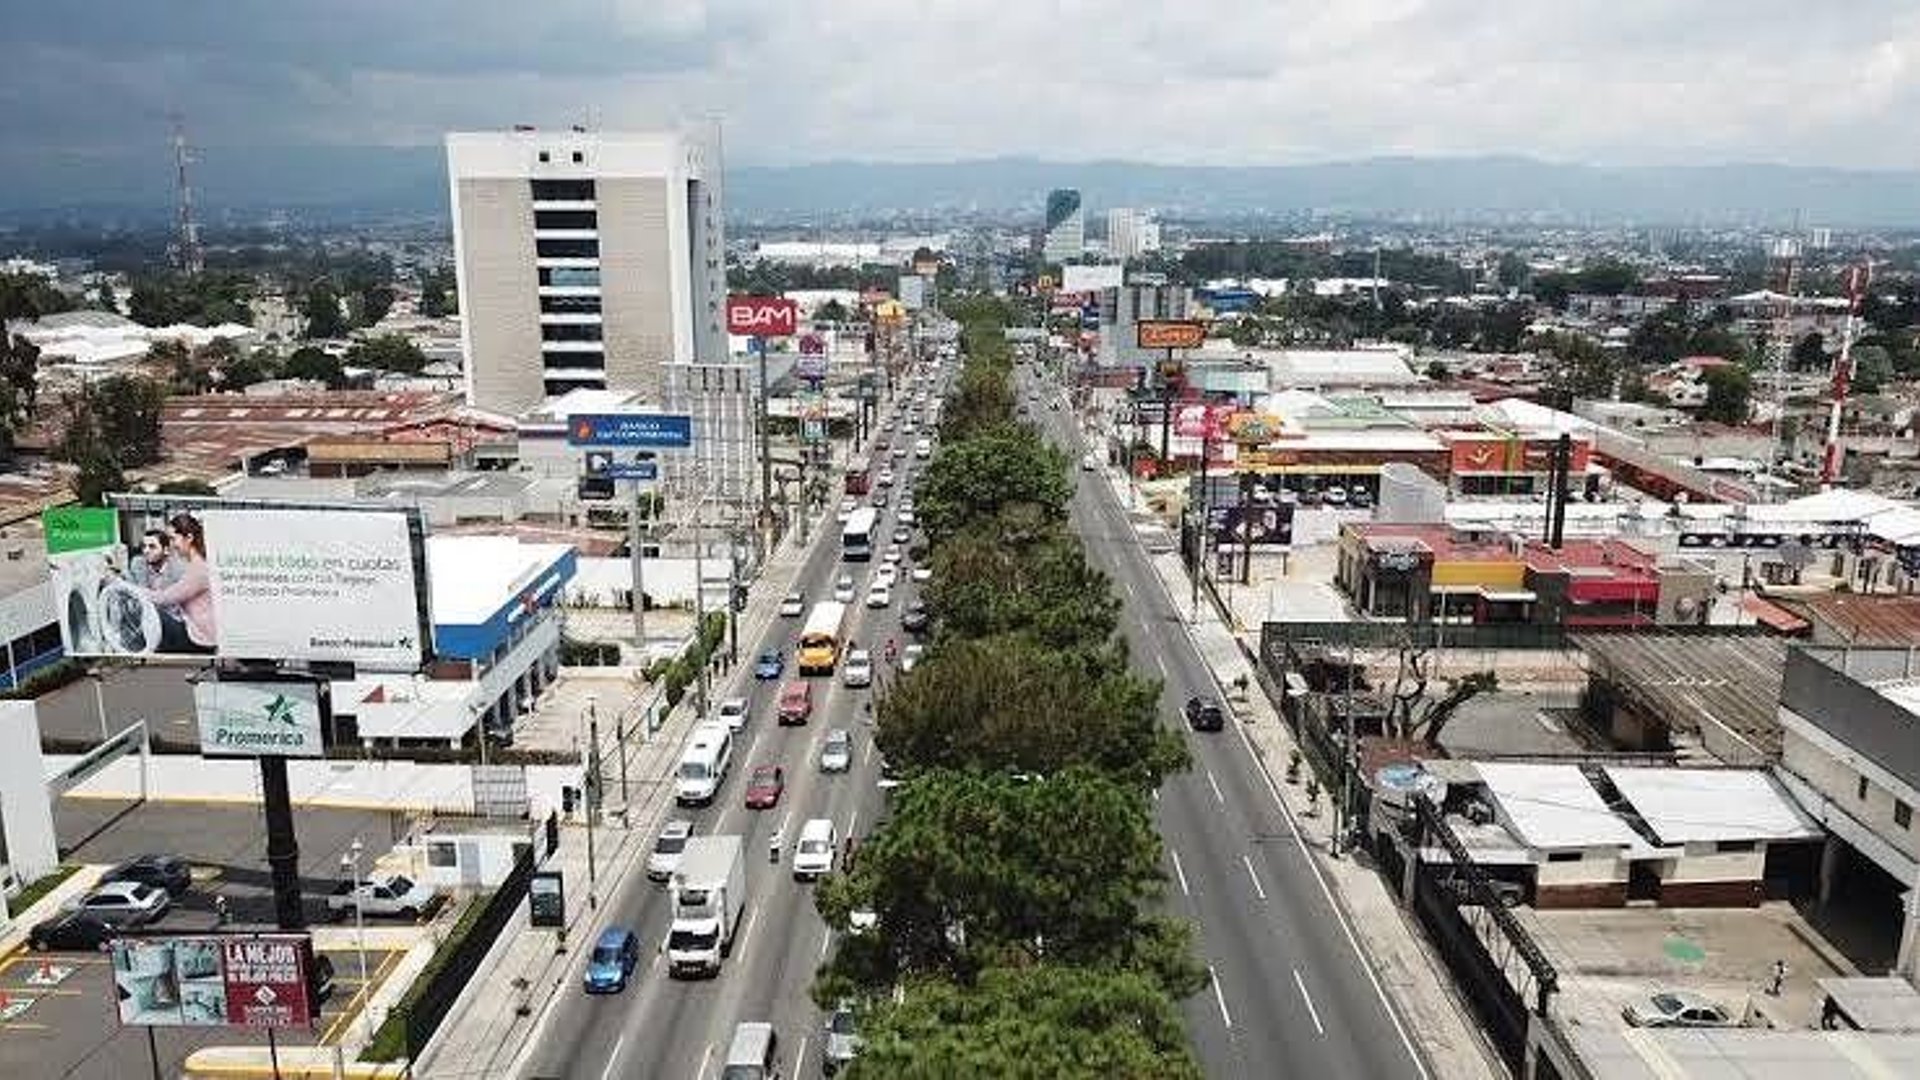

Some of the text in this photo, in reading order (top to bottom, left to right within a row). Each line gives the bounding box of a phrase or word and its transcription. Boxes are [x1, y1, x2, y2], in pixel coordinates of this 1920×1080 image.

[731, 306, 792, 325] BAM
[278, 553, 319, 570] todo
[322, 559, 345, 571] en
[348, 557, 402, 572] cuotas
[215, 727, 303, 745] Promerica
[227, 944, 295, 964] LA MEJOR
